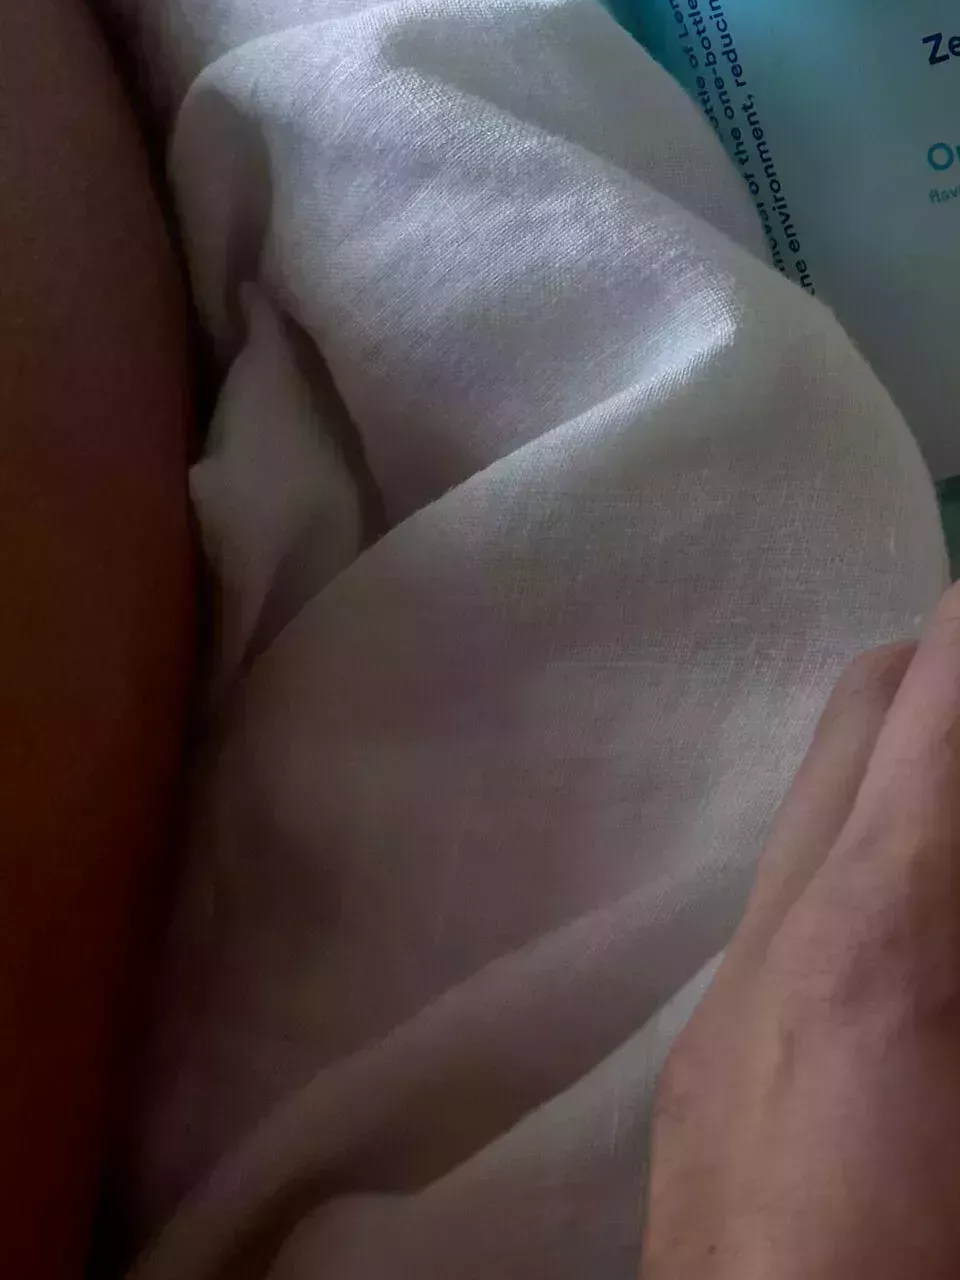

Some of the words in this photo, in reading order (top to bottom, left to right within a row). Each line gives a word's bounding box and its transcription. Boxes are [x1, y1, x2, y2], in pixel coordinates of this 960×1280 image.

[683, 45, 699, 69] of
[730, 127, 750, 166] the
[742, 93, 801, 253] environment,
